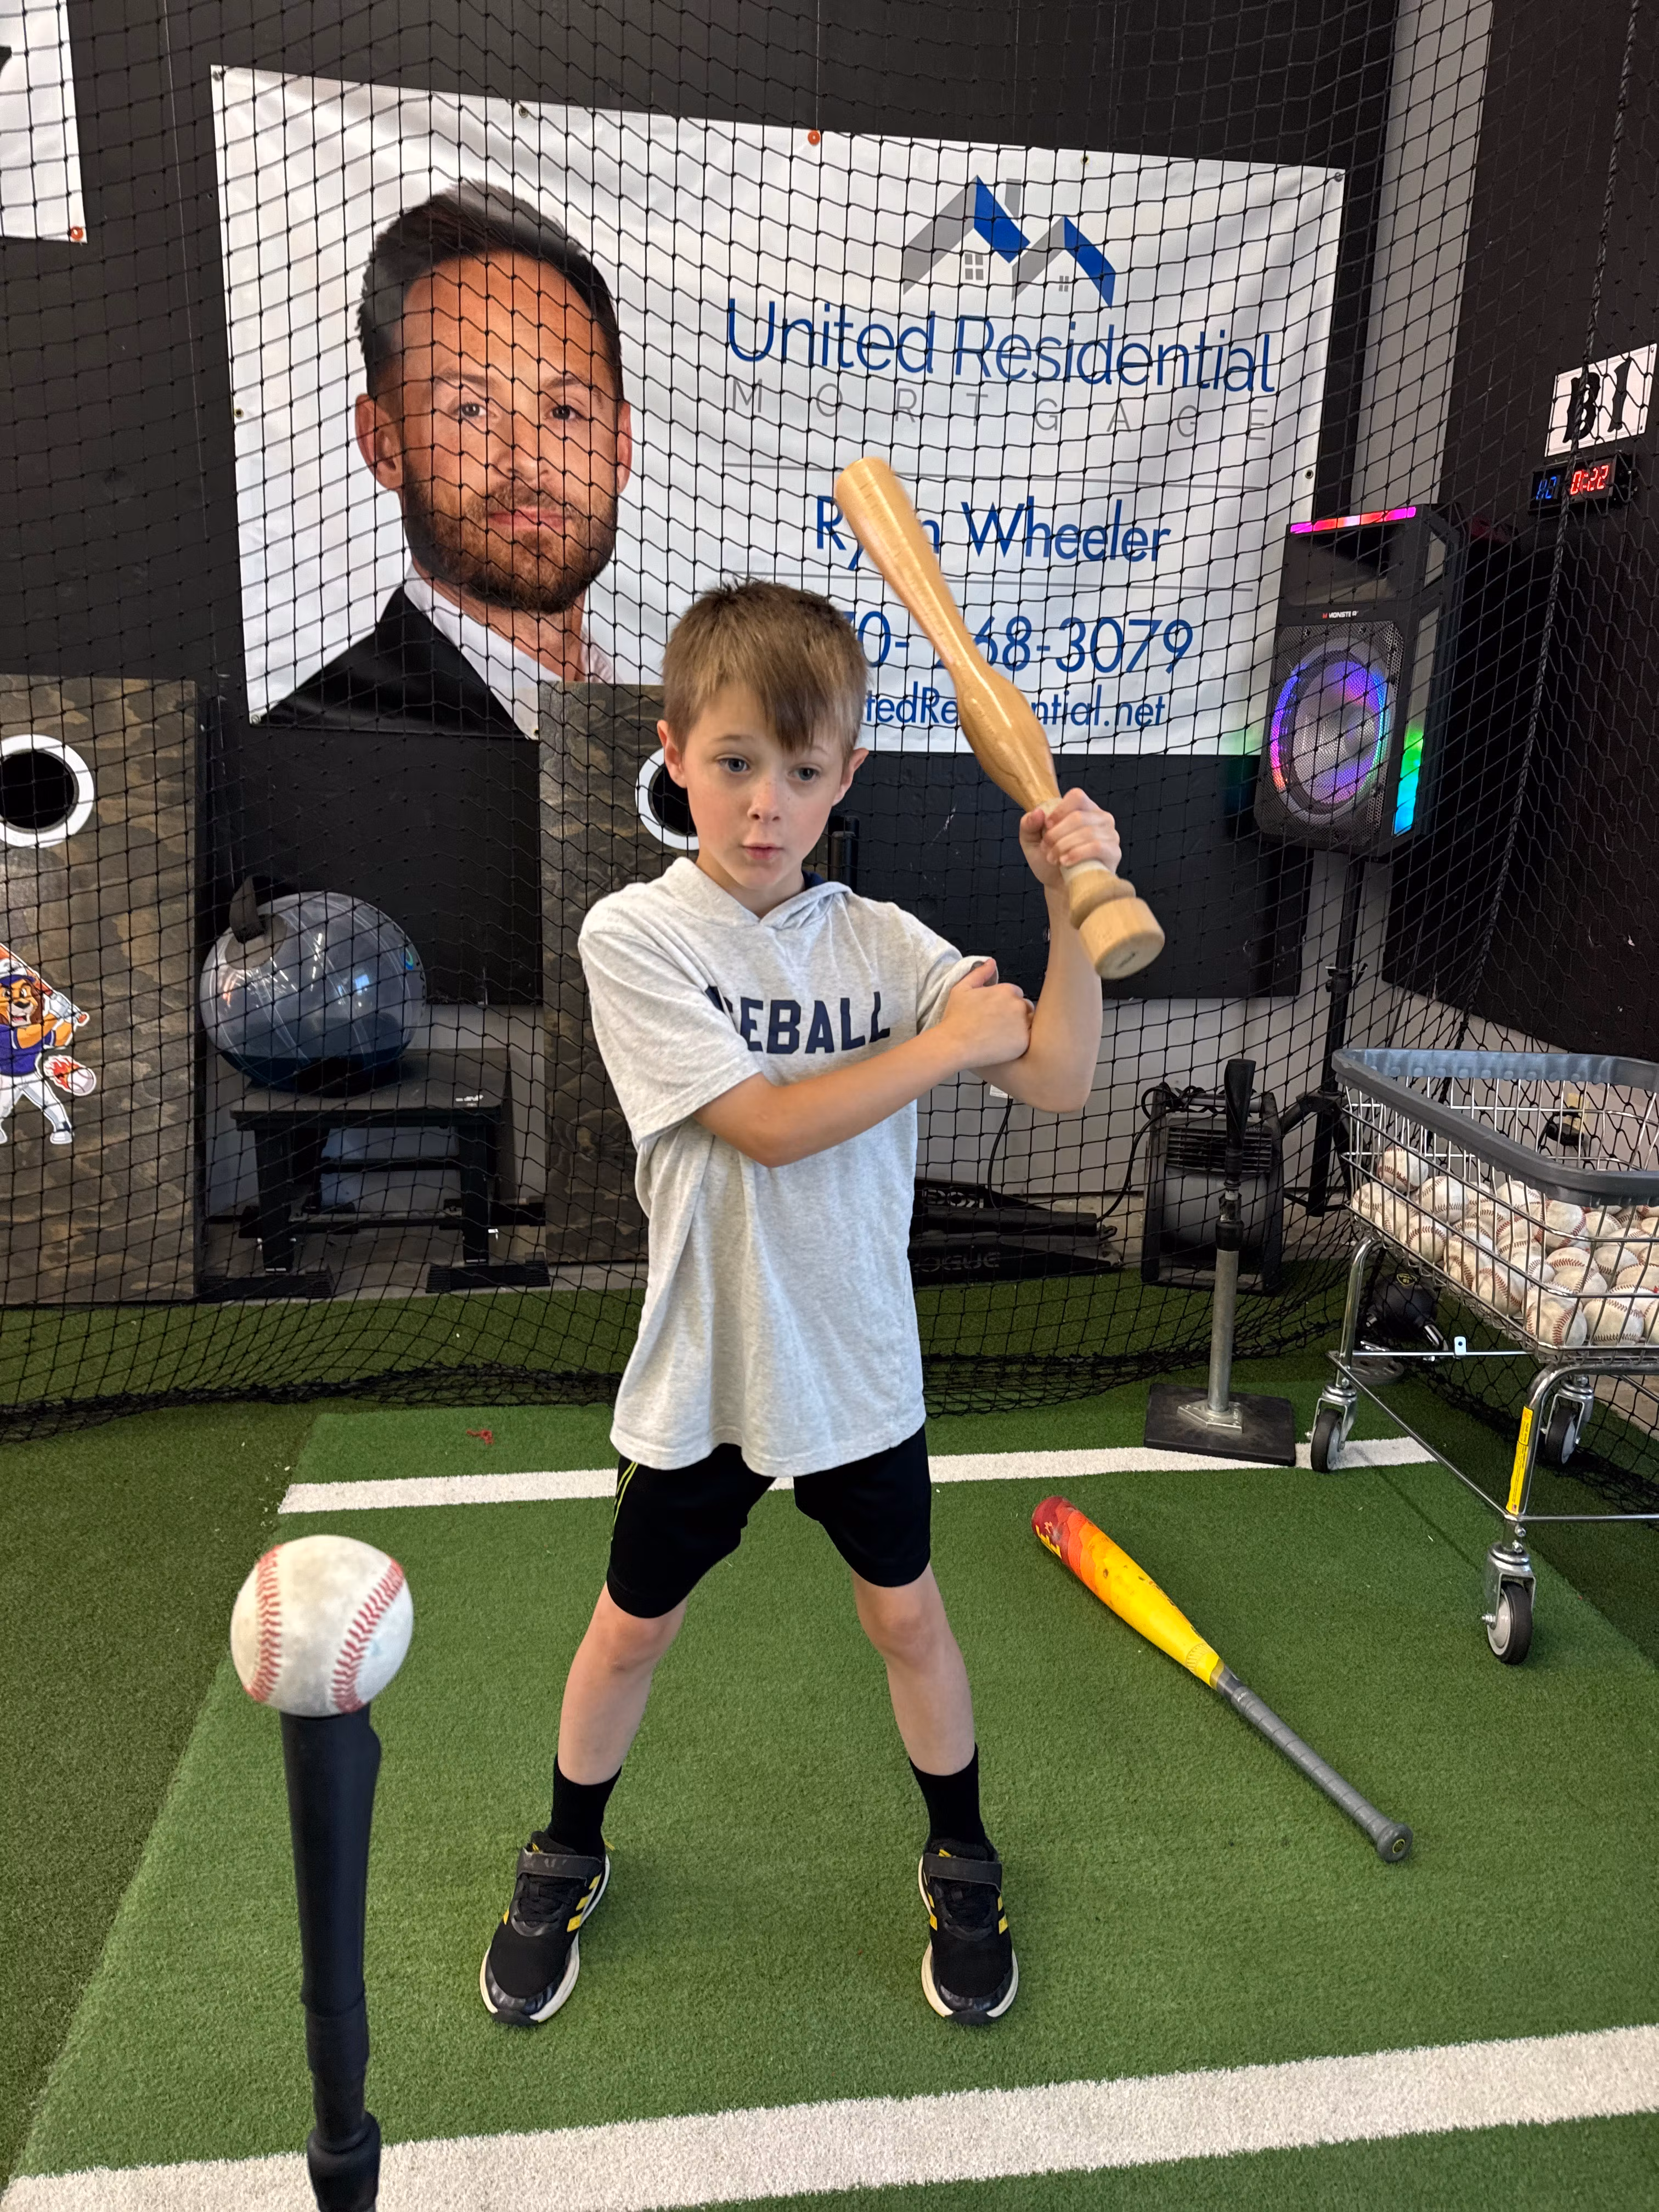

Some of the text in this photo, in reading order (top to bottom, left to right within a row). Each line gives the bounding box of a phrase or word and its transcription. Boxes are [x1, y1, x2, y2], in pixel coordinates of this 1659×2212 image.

[728, 298, 1275, 392] United Residential
[731, 378, 1268, 441] MORTGAGE
[816, 495, 1172, 571] Rn Wheeler
[843, 611, 1193, 674] 0-68-3079
[705, 986, 890, 1055] EBALL
